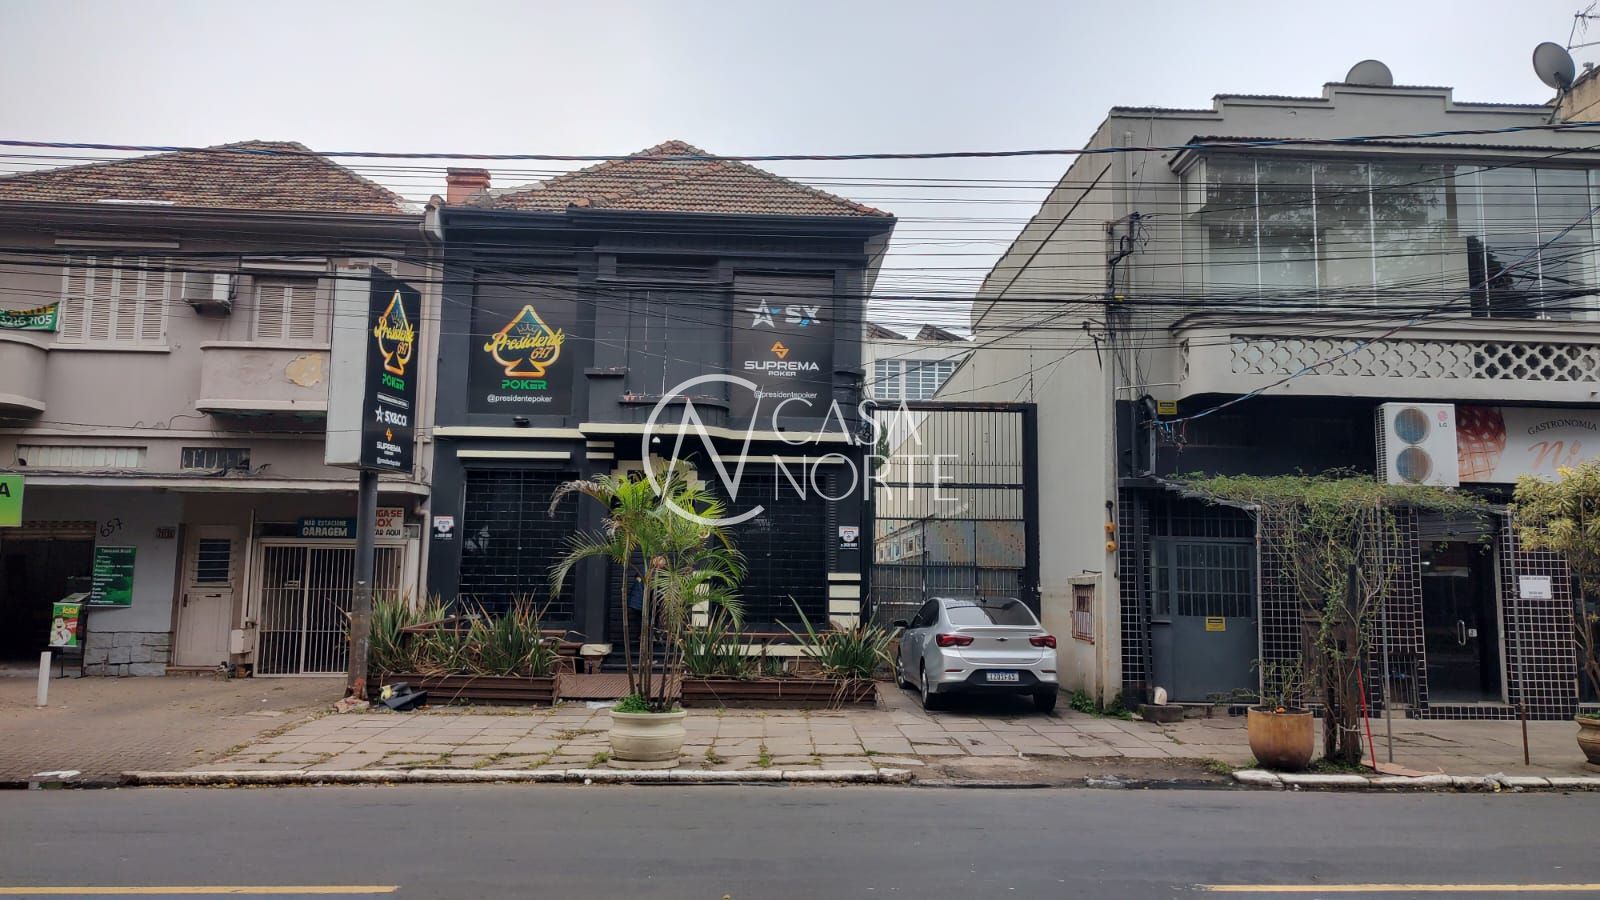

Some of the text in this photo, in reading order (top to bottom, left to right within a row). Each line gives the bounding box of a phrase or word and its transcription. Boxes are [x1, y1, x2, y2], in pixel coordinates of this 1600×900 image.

[374, 316, 414, 343] Presidente
[483, 328, 565, 352] Presidente
[530, 347, 553, 359] 647
[744, 360, 819, 371] SUPREMA
[382, 373, 405, 391] POKER
[501, 379, 547, 390] POKER
[487, 393, 553, 403] @presidentepoker
[754, 390, 817, 399] @presidentepoker
[1527, 419, 1597, 435] GASTRONOMIA
[100, 517, 123, 537] 657
[375, 518, 393, 528] OX
[302, 526, 348, 537] GARAGEM
